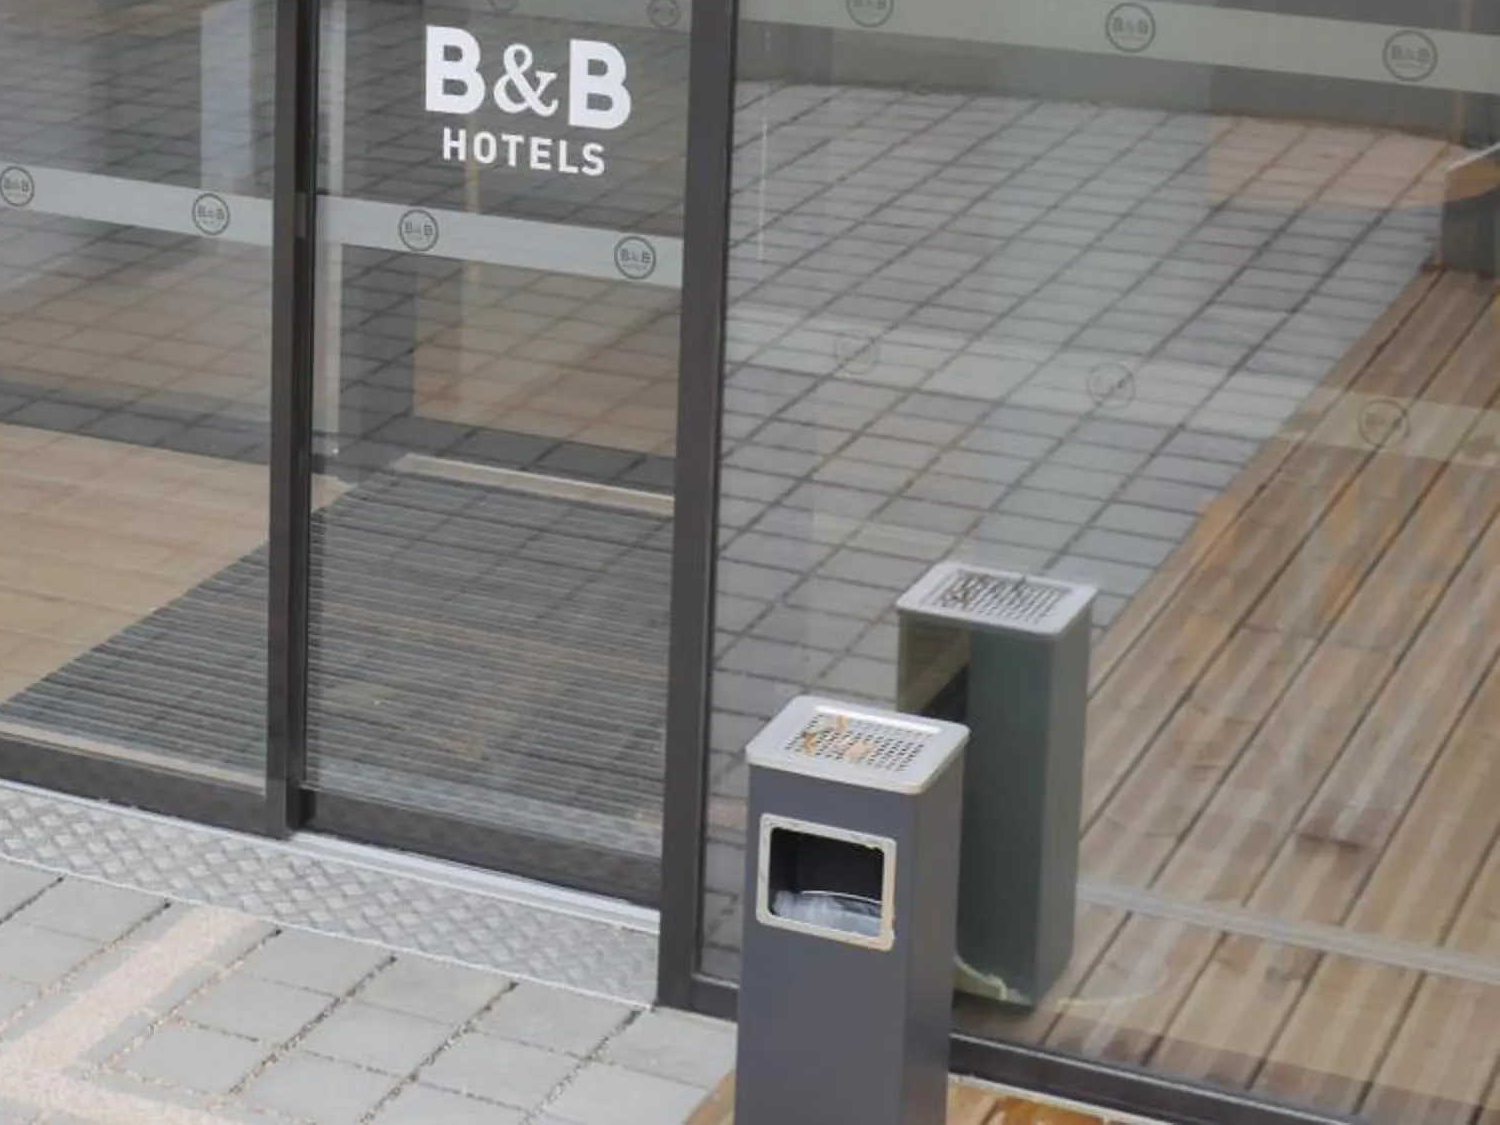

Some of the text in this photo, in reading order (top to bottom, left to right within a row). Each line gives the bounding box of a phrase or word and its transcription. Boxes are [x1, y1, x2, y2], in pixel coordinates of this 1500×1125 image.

[1113, 16, 1149, 35] B&B
[425, 24, 632, 130] B&B
[443, 126, 606, 176] HOTELS
